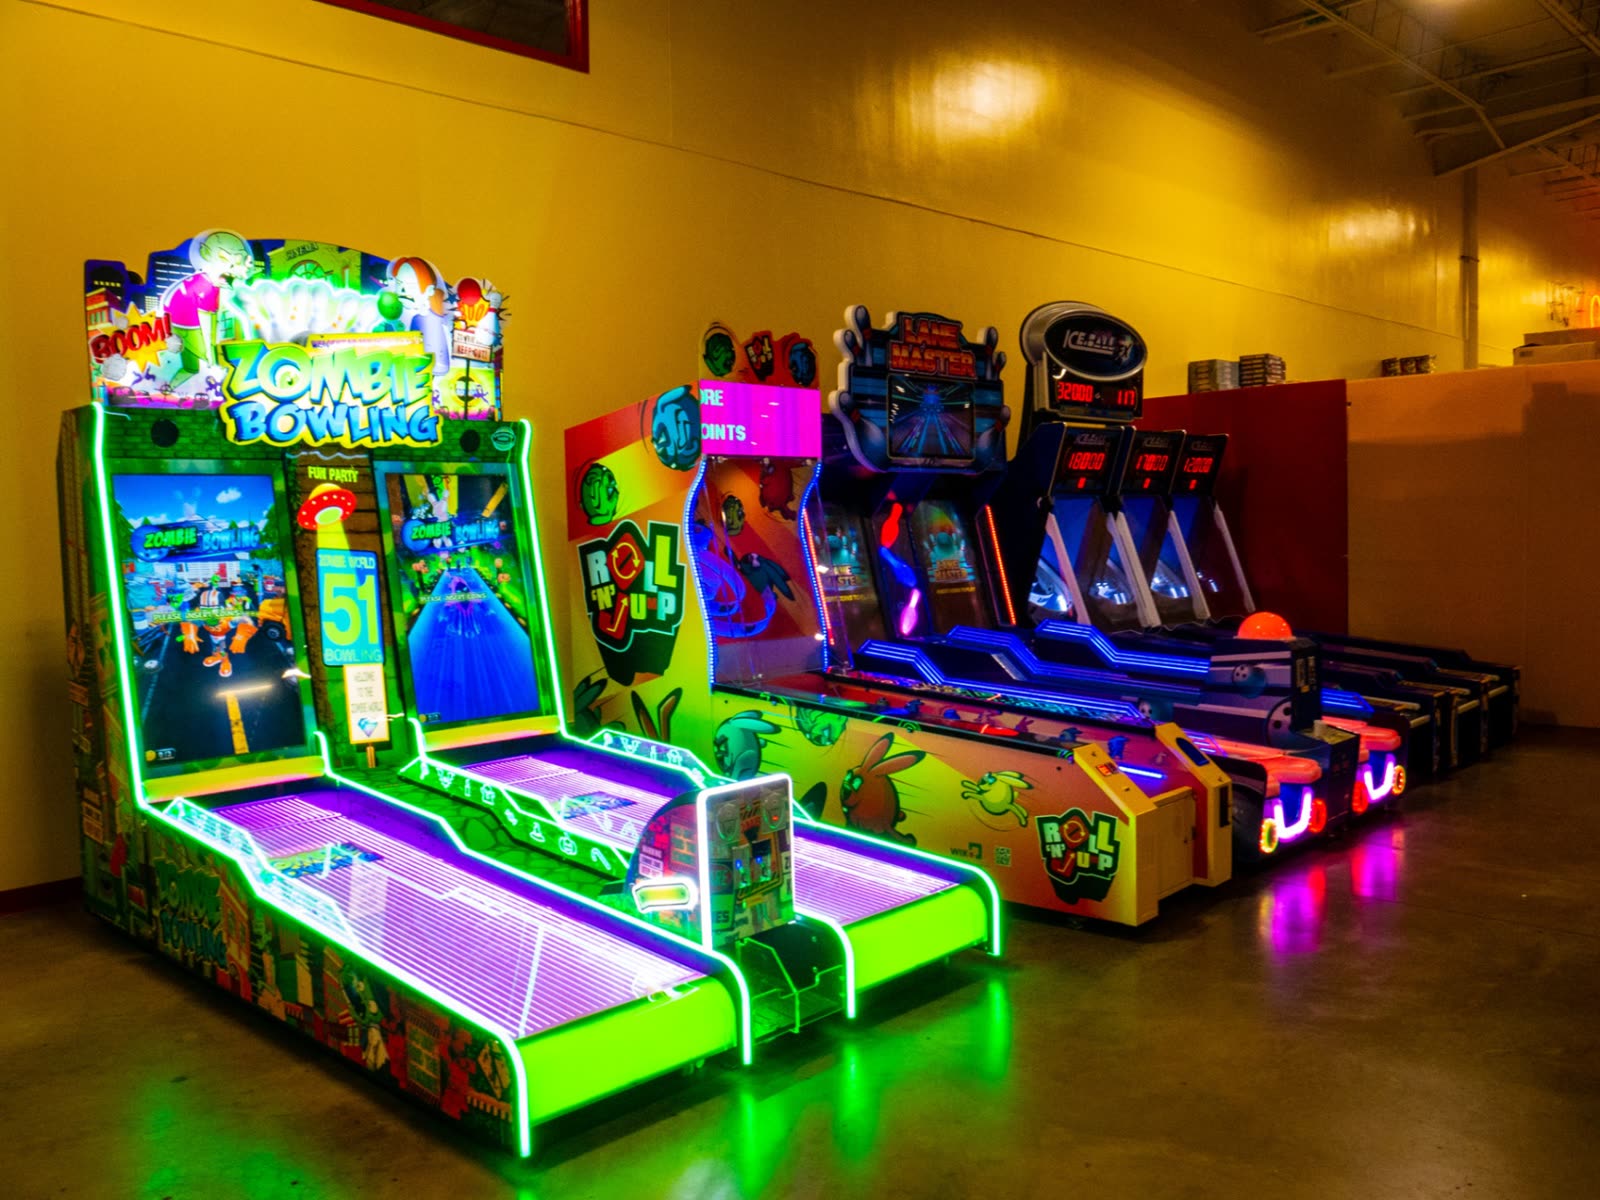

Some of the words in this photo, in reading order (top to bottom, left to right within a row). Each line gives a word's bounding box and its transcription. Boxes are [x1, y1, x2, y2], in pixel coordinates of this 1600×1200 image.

[90, 313, 172, 364] BOOM!
[903, 316, 959, 350] LANE
[228, 343, 433, 404] ZOMBIE
[891, 342, 977, 378] MASTER
[1057, 381, 1094, 402] 32000
[228, 401, 439, 443] BOWLING
[308, 466, 327, 480] FUN
[329, 468, 359, 483] PARTY
[144, 527, 197, 549] ZOMBIE
[202, 525, 260, 551] BOWLING
[411, 521, 451, 540] ZOMBIE
[586, 532, 677, 594] ROLL
[153, 611, 181, 622] PLEASE
[323, 573, 378, 646] 51
[324, 648, 382, 663] BOWLING
[1043, 816, 1114, 854] ROLL
